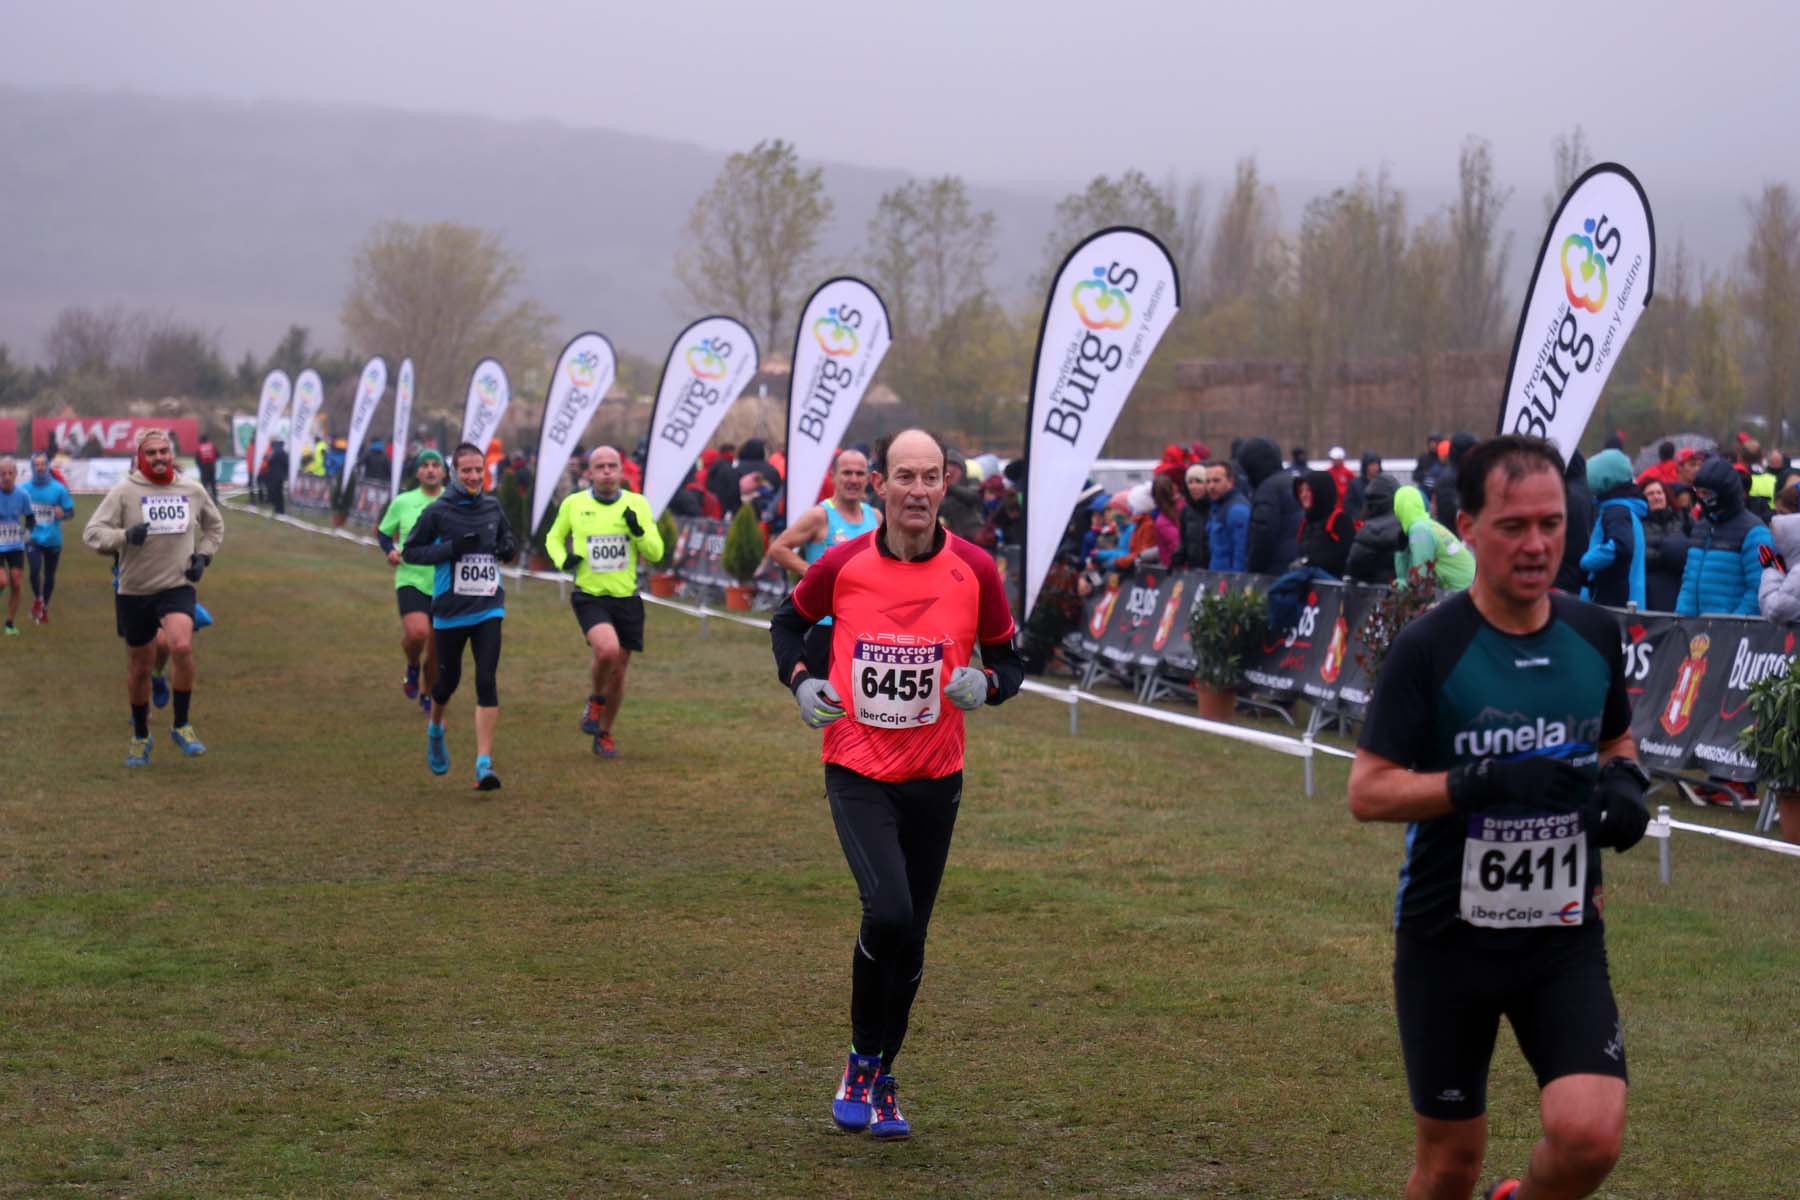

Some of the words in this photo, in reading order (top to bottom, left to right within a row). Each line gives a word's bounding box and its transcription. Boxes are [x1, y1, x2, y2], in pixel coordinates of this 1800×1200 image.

[1617, 253, 1644, 314] destino
[1612, 310, 1626, 327] y
[1593, 323, 1618, 374] origen
[1522, 317, 1561, 400] Provincia
[148, 505, 186, 521] 6605
[592, 544, 627, 560] 6004
[461, 565, 496, 582] 6049
[856, 632, 955, 646] ARENA
[861, 652, 936, 664] BURGOS
[862, 643, 936, 656] DIPUTACIÓN
[860, 666, 935, 701] 6455
[859, 708, 908, 726] iberCaja
[1481, 824, 1580, 842] BURGOS
[1479, 843, 1579, 892] 6411
[1470, 905, 1544, 922] iberCaja
